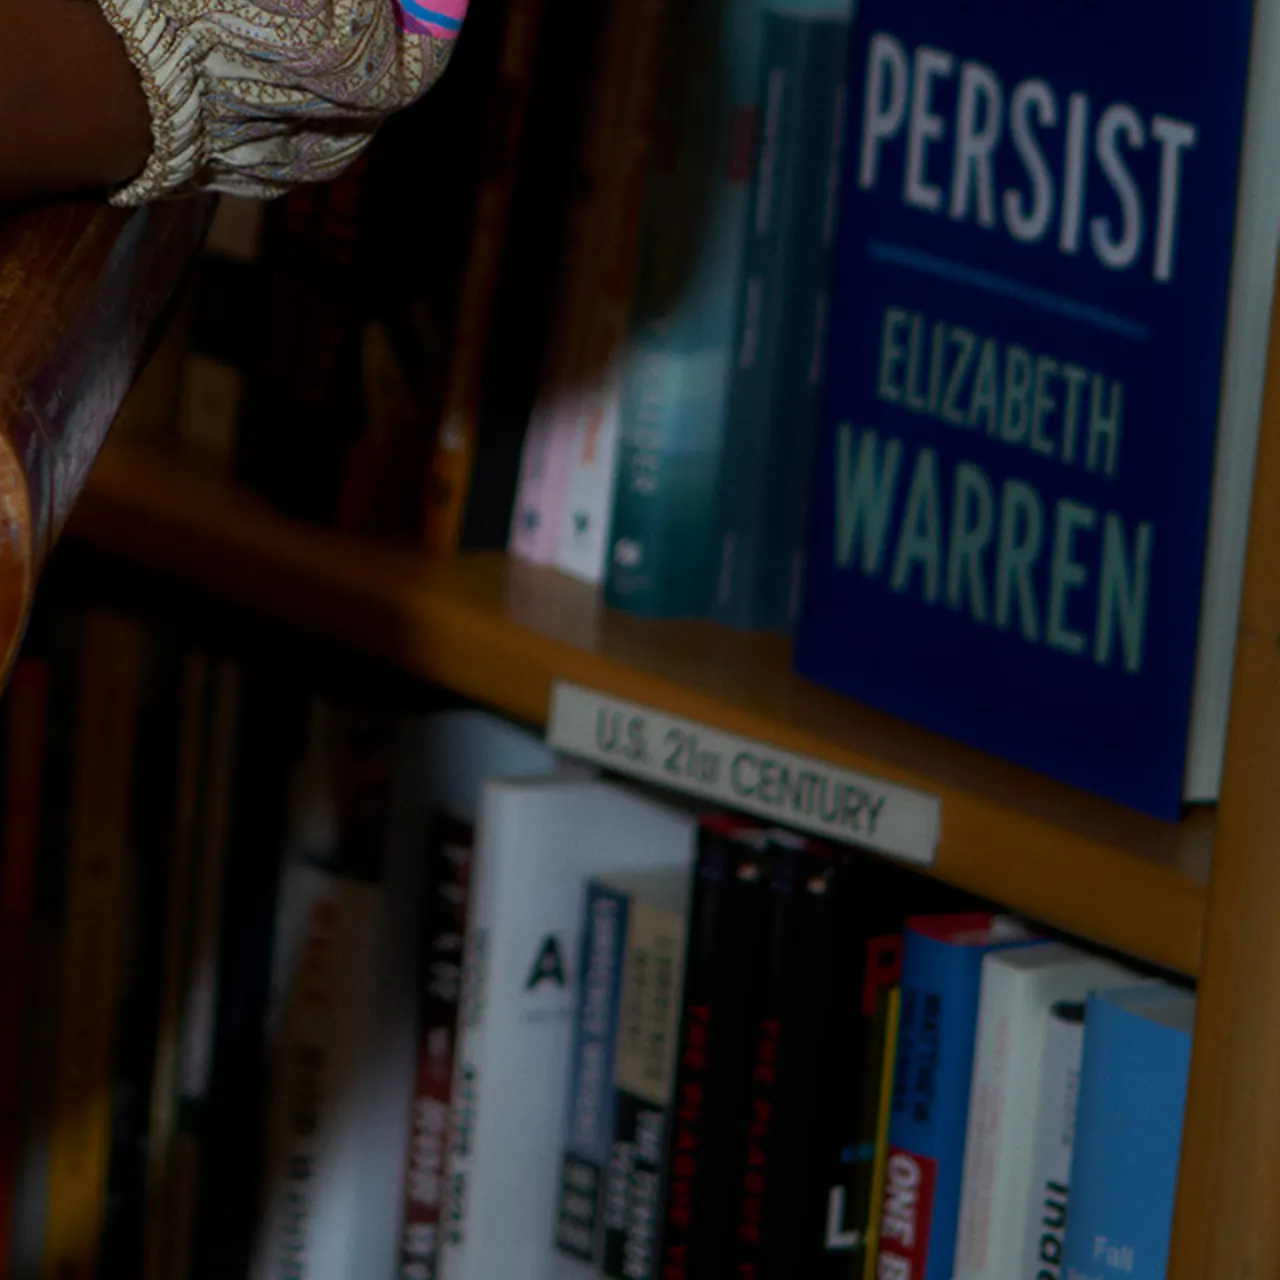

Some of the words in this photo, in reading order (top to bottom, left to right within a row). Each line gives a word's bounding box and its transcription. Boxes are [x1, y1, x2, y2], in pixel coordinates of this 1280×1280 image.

[858, 31, 1196, 282] PERSIST
[878, 307, 1124, 478] ELIZABETH
[833, 421, 1151, 676] WARREN
[596, 707, 651, 763] U.S.
[729, 751, 887, 836] CENTURY
[880, 1152, 922, 1244] ONE
